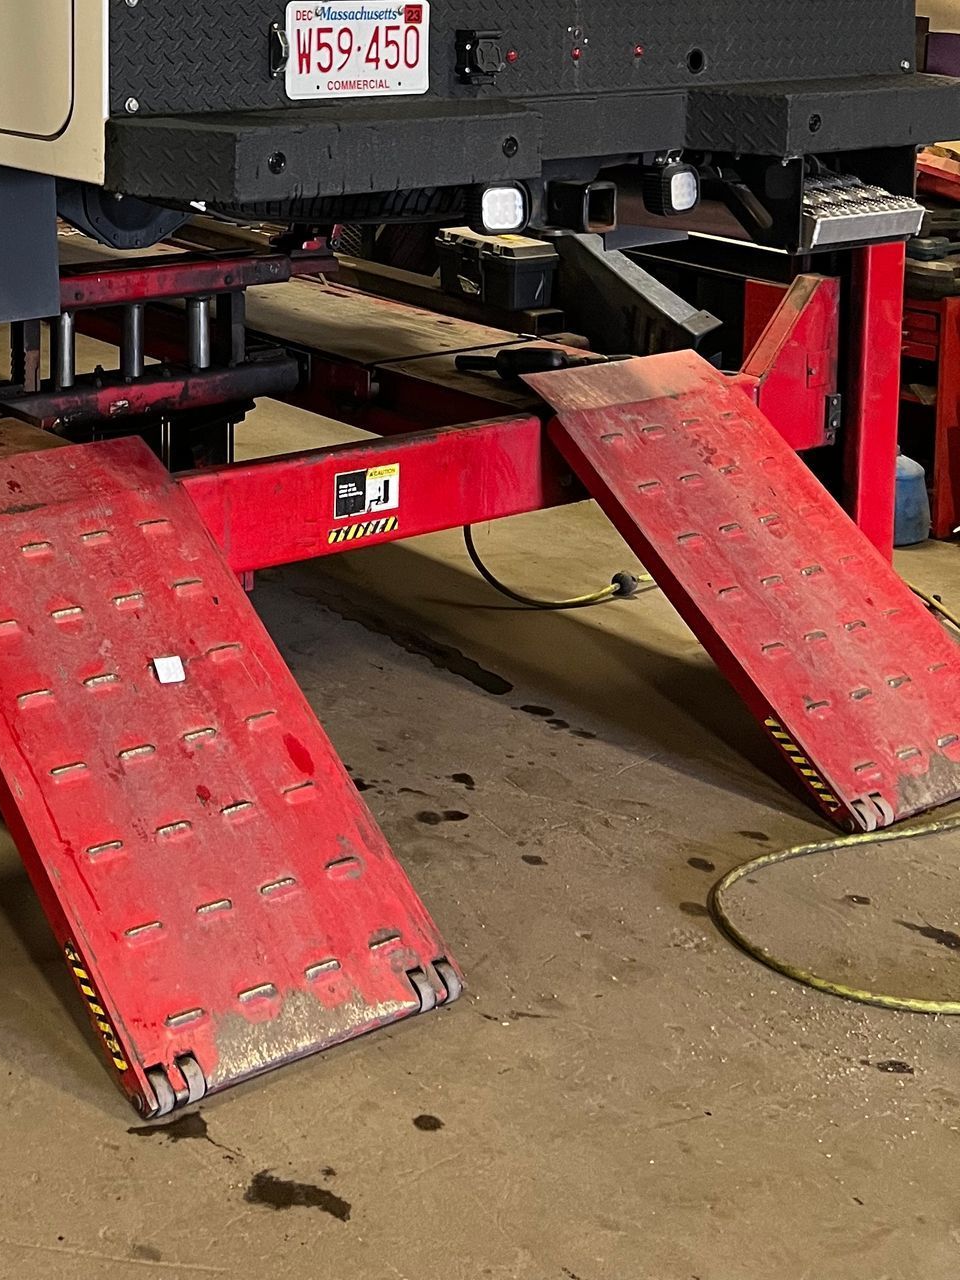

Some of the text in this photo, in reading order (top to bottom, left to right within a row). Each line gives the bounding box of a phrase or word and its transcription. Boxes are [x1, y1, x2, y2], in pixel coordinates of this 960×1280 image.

[296, 6, 420, 21] DEC Massachusetts 23
[327, 79, 390, 91] COMMERCIAL
